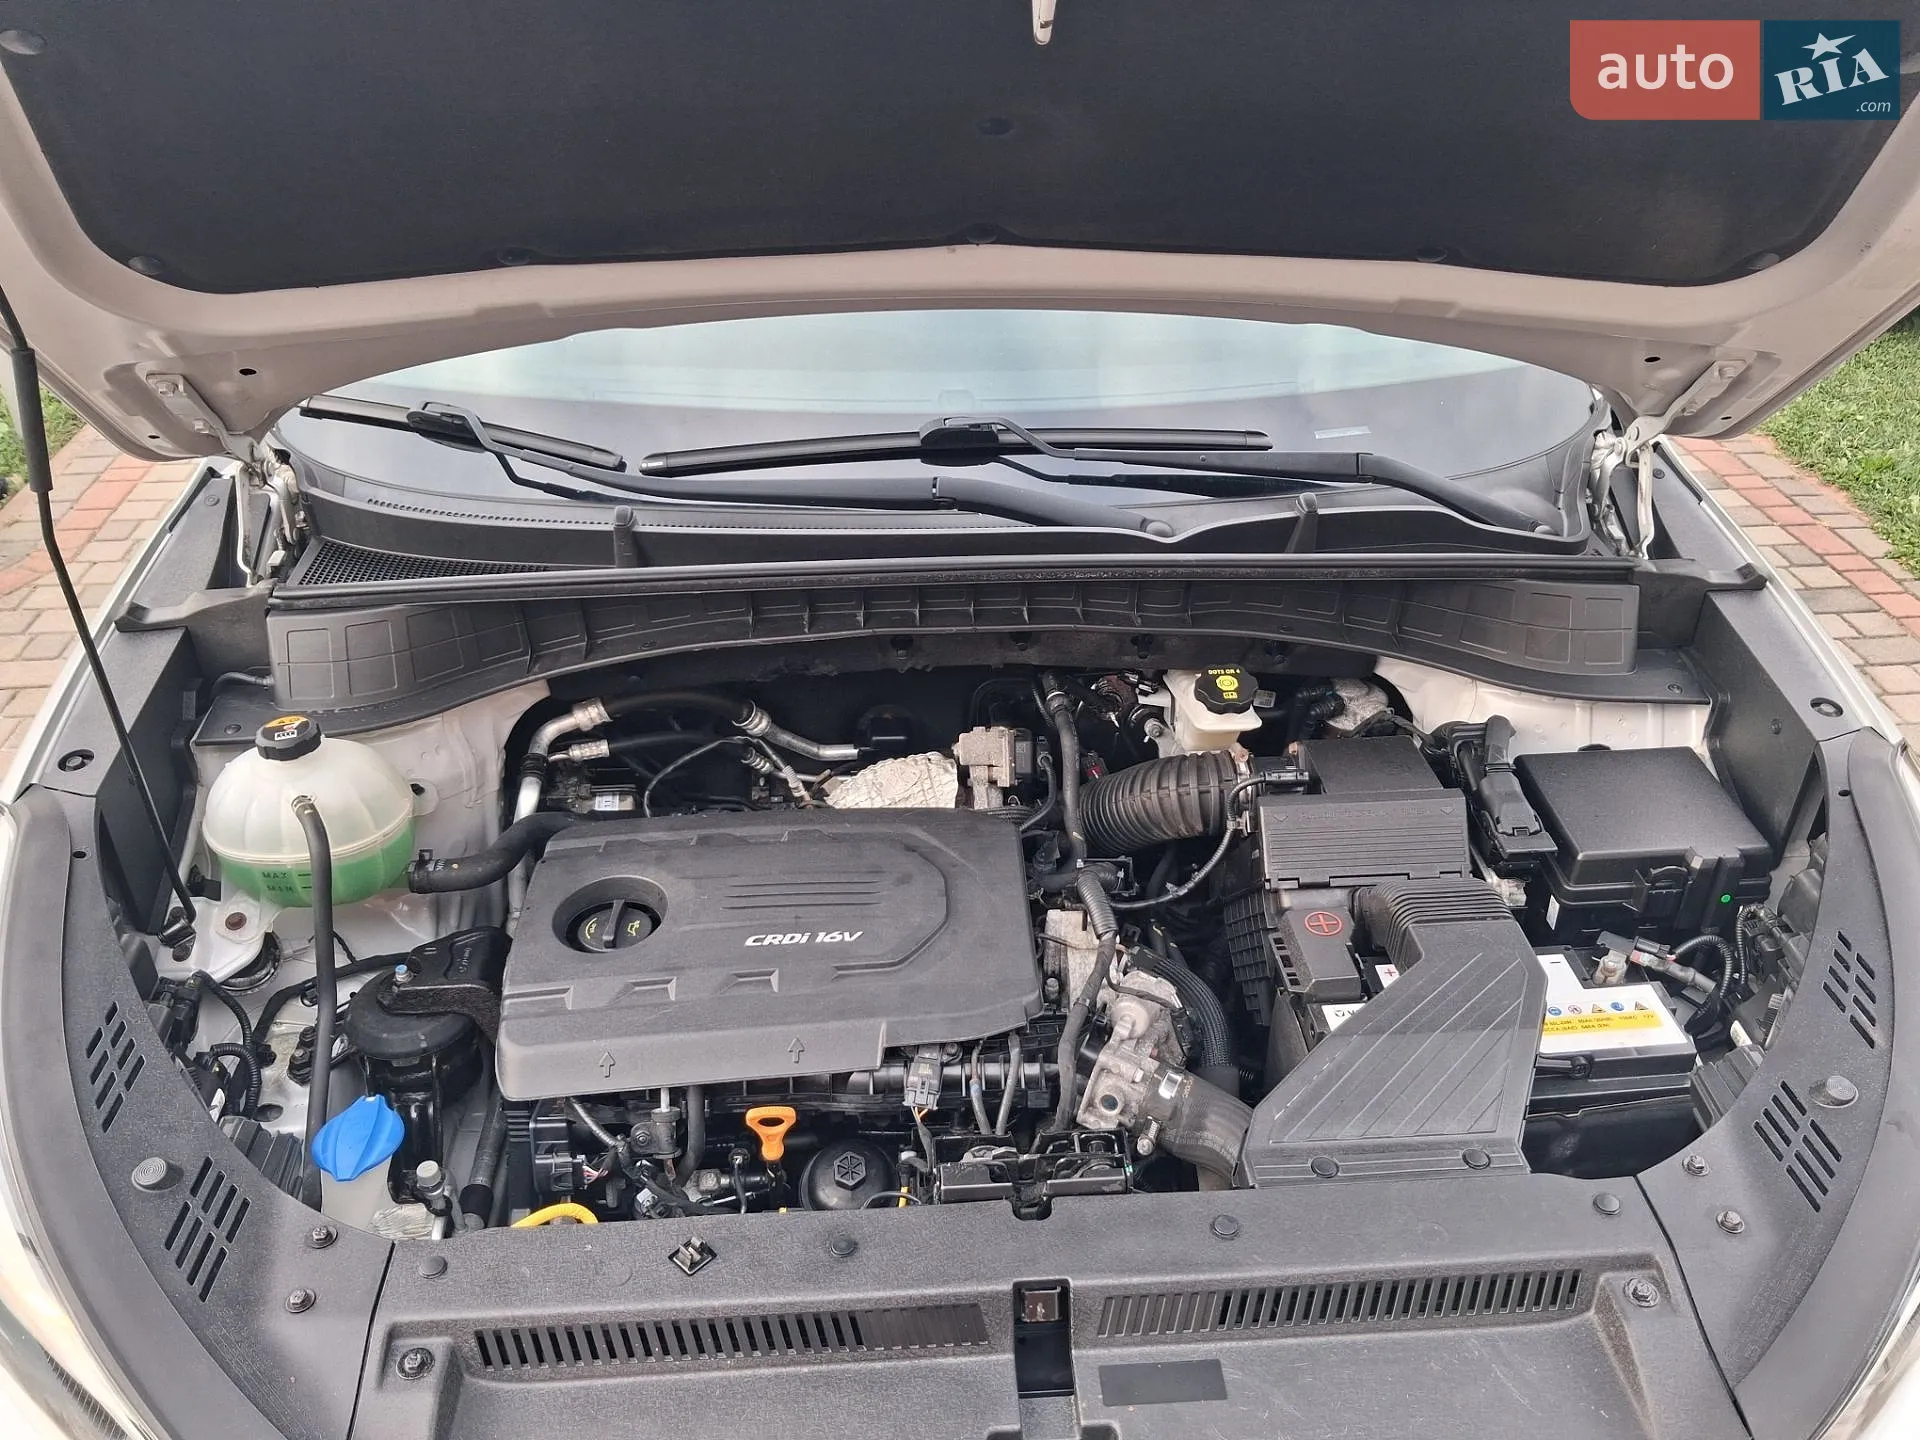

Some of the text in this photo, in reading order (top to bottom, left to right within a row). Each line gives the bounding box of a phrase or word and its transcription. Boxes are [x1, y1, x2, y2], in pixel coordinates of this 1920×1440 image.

[262, 871, 289, 879] MAX
[744, 931, 863, 946] CRDi 16V
